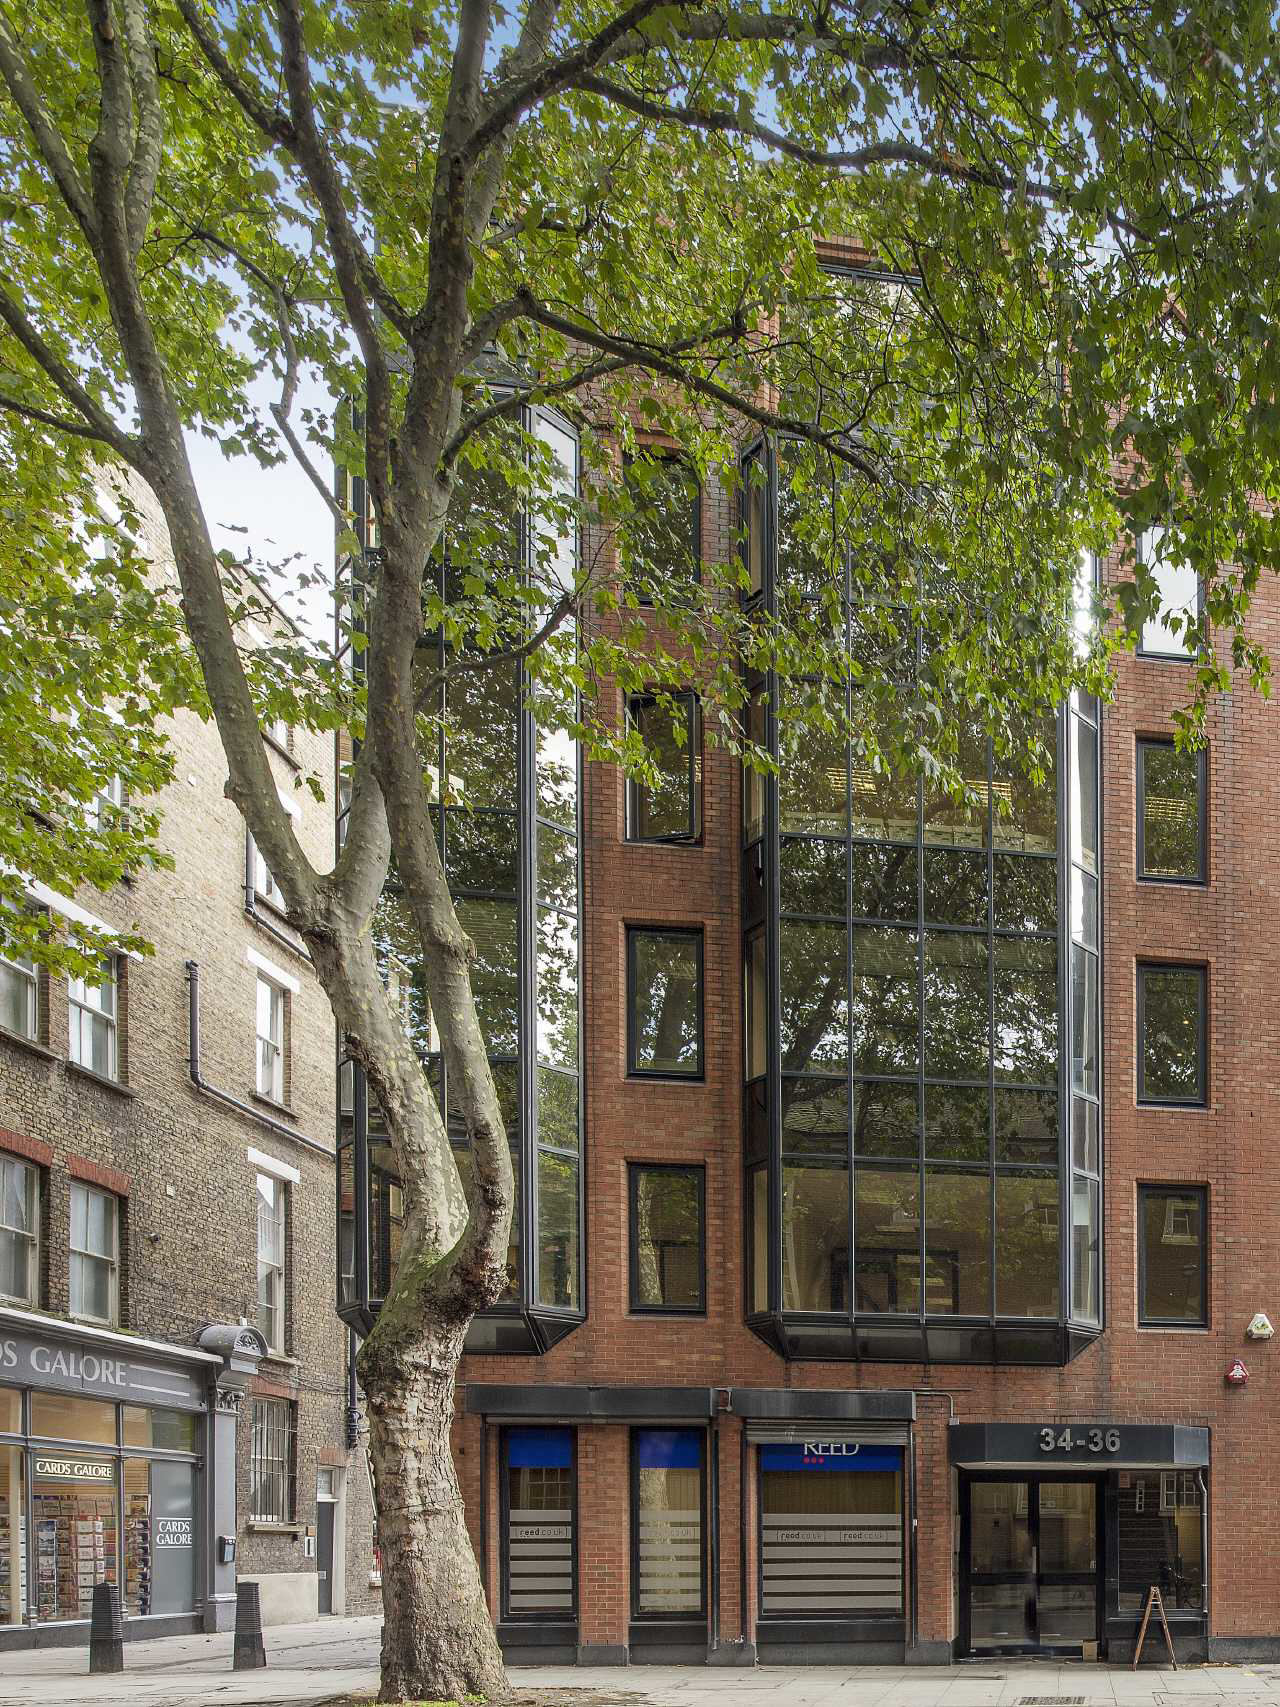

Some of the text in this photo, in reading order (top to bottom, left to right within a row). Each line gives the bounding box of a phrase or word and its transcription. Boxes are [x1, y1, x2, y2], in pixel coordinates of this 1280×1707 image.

[30, 1346, 127, 1386] GALORE
[1039, 1428, 1121, 1452] 34-36
[36, 1461, 112, 1478] CARDS GALORE
[158, 1521, 190, 1533] CARDS
[156, 1533, 192, 1545] GALORE
